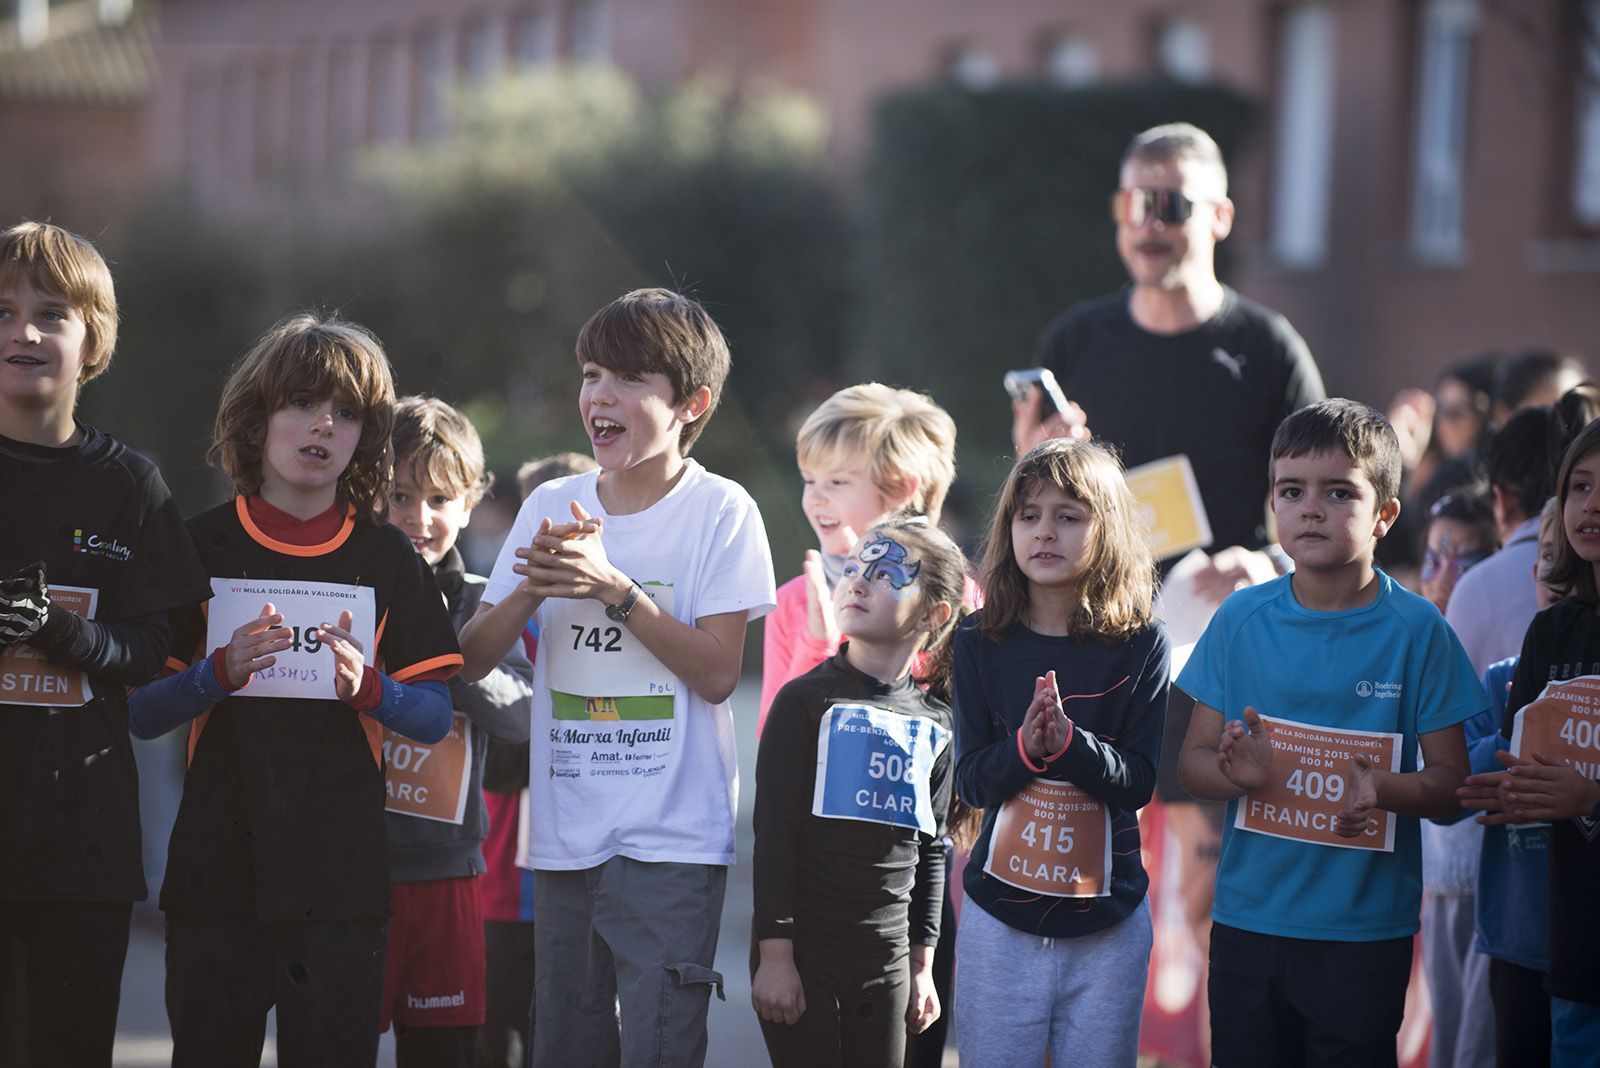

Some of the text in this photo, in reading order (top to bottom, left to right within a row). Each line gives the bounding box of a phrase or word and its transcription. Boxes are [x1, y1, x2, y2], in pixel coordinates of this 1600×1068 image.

[311, 590, 357, 600] VALLDOREIX
[571, 624, 622, 652] 742
[1, 672, 68, 694] STIEN
[1570, 704, 1590, 714] 800
[563, 728, 614, 744] Marxa
[615, 728, 671, 747] Infantil
[1335, 738, 1383, 749] VALLDOREIX
[868, 752, 917, 785] 508
[1300, 755, 1334, 769] 800 M
[1286, 768, 1344, 802] 409
[1034, 809, 1055, 820] 800
[1058, 803, 1099, 812] 2015-2016
[1021, 821, 1075, 854] 415
[1009, 855, 1083, 883] CLARA
[407, 990, 465, 1009] hummel
